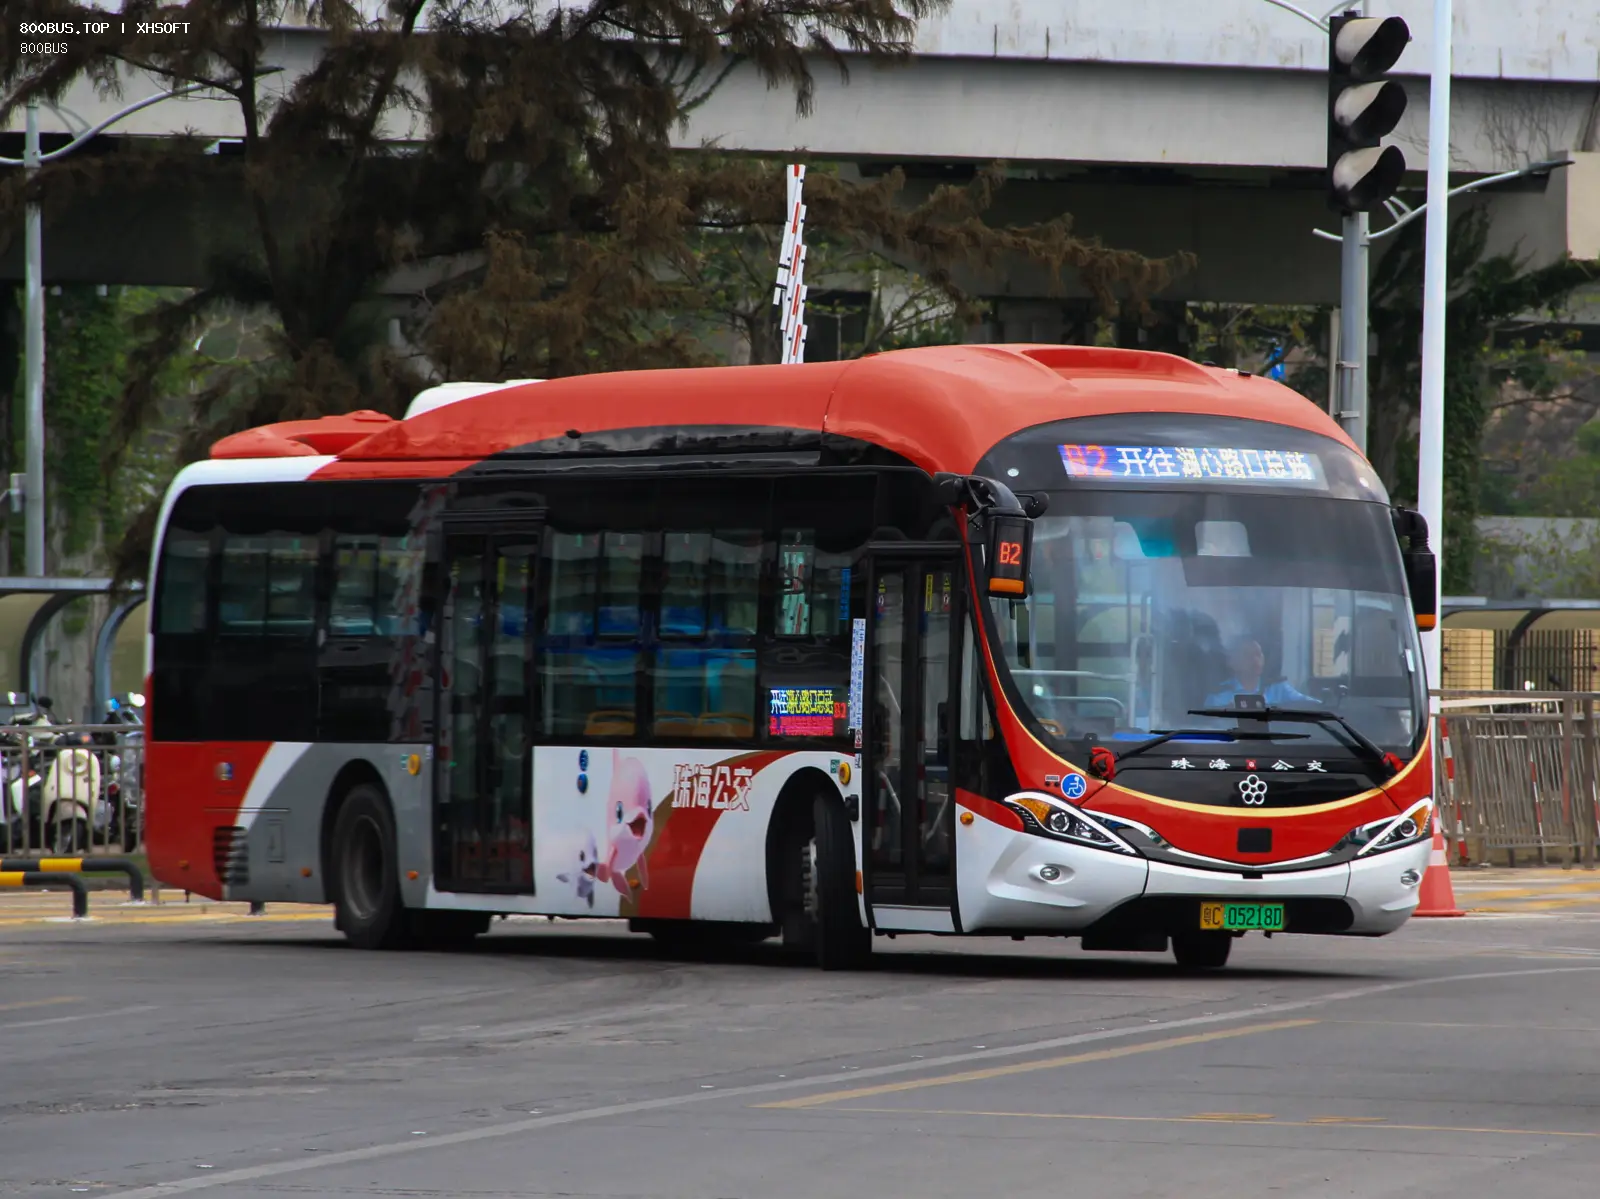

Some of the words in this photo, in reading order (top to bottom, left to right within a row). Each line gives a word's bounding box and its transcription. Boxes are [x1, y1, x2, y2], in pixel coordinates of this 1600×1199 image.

[1063, 444, 1112, 477] B2
[1000, 541, 1021, 565] B2
[671, 763, 753, 812] 珠海公交
